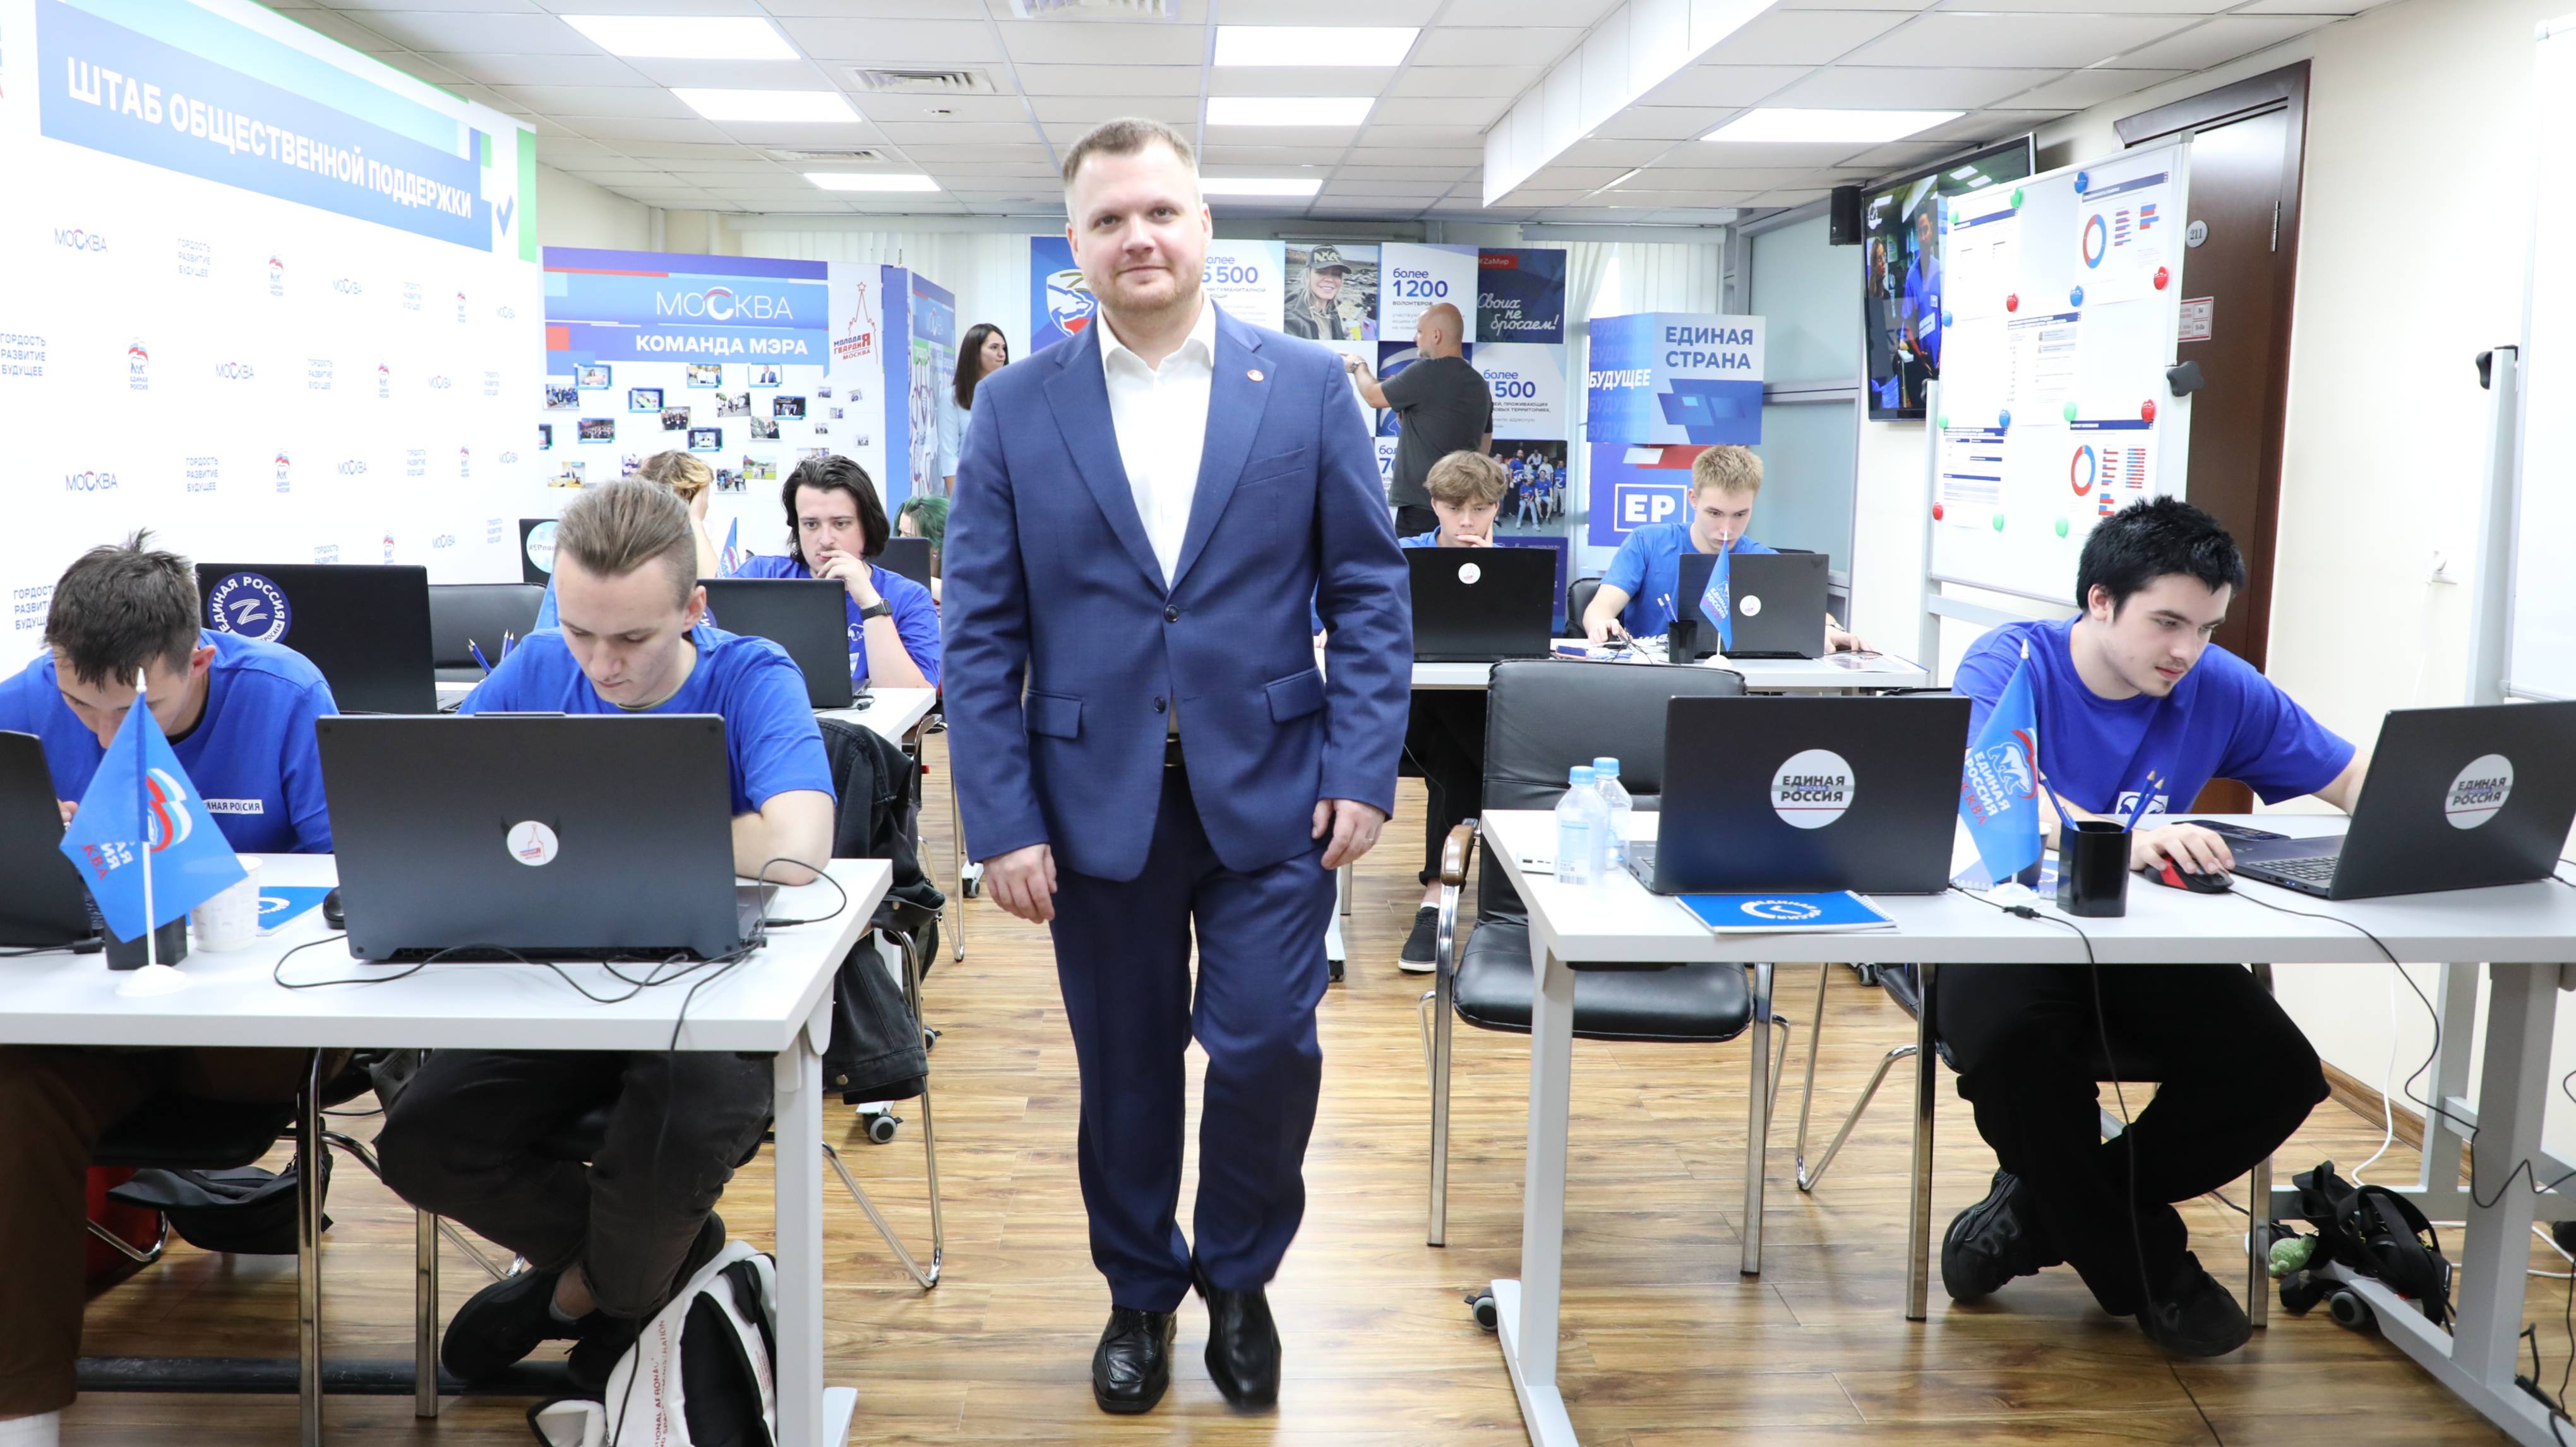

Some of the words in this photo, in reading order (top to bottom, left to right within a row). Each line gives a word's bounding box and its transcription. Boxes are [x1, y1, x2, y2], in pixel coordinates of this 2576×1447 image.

[67, 56, 163, 125] ШТАБ
[169, 93, 365, 188] ОБЩЕСТВЕННОЙ
[368, 160, 472, 220] ПОДДЕРЖКИ
[55, 227, 108, 253] МОСКВА
[2190, 229, 2202, 240] 211
[1206, 256, 1235, 265] олее
[1393, 268, 1429, 278] более
[656, 286, 793, 320] МОСКВА
[1477, 292, 1521, 309] Своих
[1505, 309, 1522, 319] не
[1490, 314, 1559, 336] бросаем!
[0, 333, 46, 347] ГОРДОСТЬ
[1665, 326, 1753, 346] ЕДИНАЯ
[636, 335, 745, 356] КОМАНДА
[749, 338, 808, 355] МЭРА
[1, 348, 46, 362] РАЗВИТИЕ
[842, 349, 871, 360] МОСКВА
[1666, 351, 1752, 369] СТРАНА
[2, 364, 44, 378] БУДУЩЕЕ
[215, 361, 254, 381] МОСКВА
[1483, 369, 1519, 379] более
[1588, 369, 1651, 391] БУДУЩЕЕ
[186, 457, 219, 467] ГОРДОСТЬ
[66, 470, 118, 492] МОСКВА
[186, 469, 219, 479] РАЗВИТИЕ
[187, 482, 217, 492] БУДУЩЕЕ
[1624, 494, 1676, 523] ЕР
[212, 578, 239, 633] ЕДИНАЯ
[243, 576, 285, 620] РОССИЯ
[15, 616, 47, 631] БУДУЩ
[1782, 775, 1845, 788] ЕДИНАЯ
[1965, 758, 1999, 816] РОССИЯ
[1974, 751, 2011, 811] ЕДИНАЯ
[2457, 777, 2507, 791] ЕДИНАЯ
[1780, 791, 1843, 802] РОССИЯ
[2452, 792, 2501, 806] РОССИЯ
[207, 801, 228, 811] ИНАЯ
